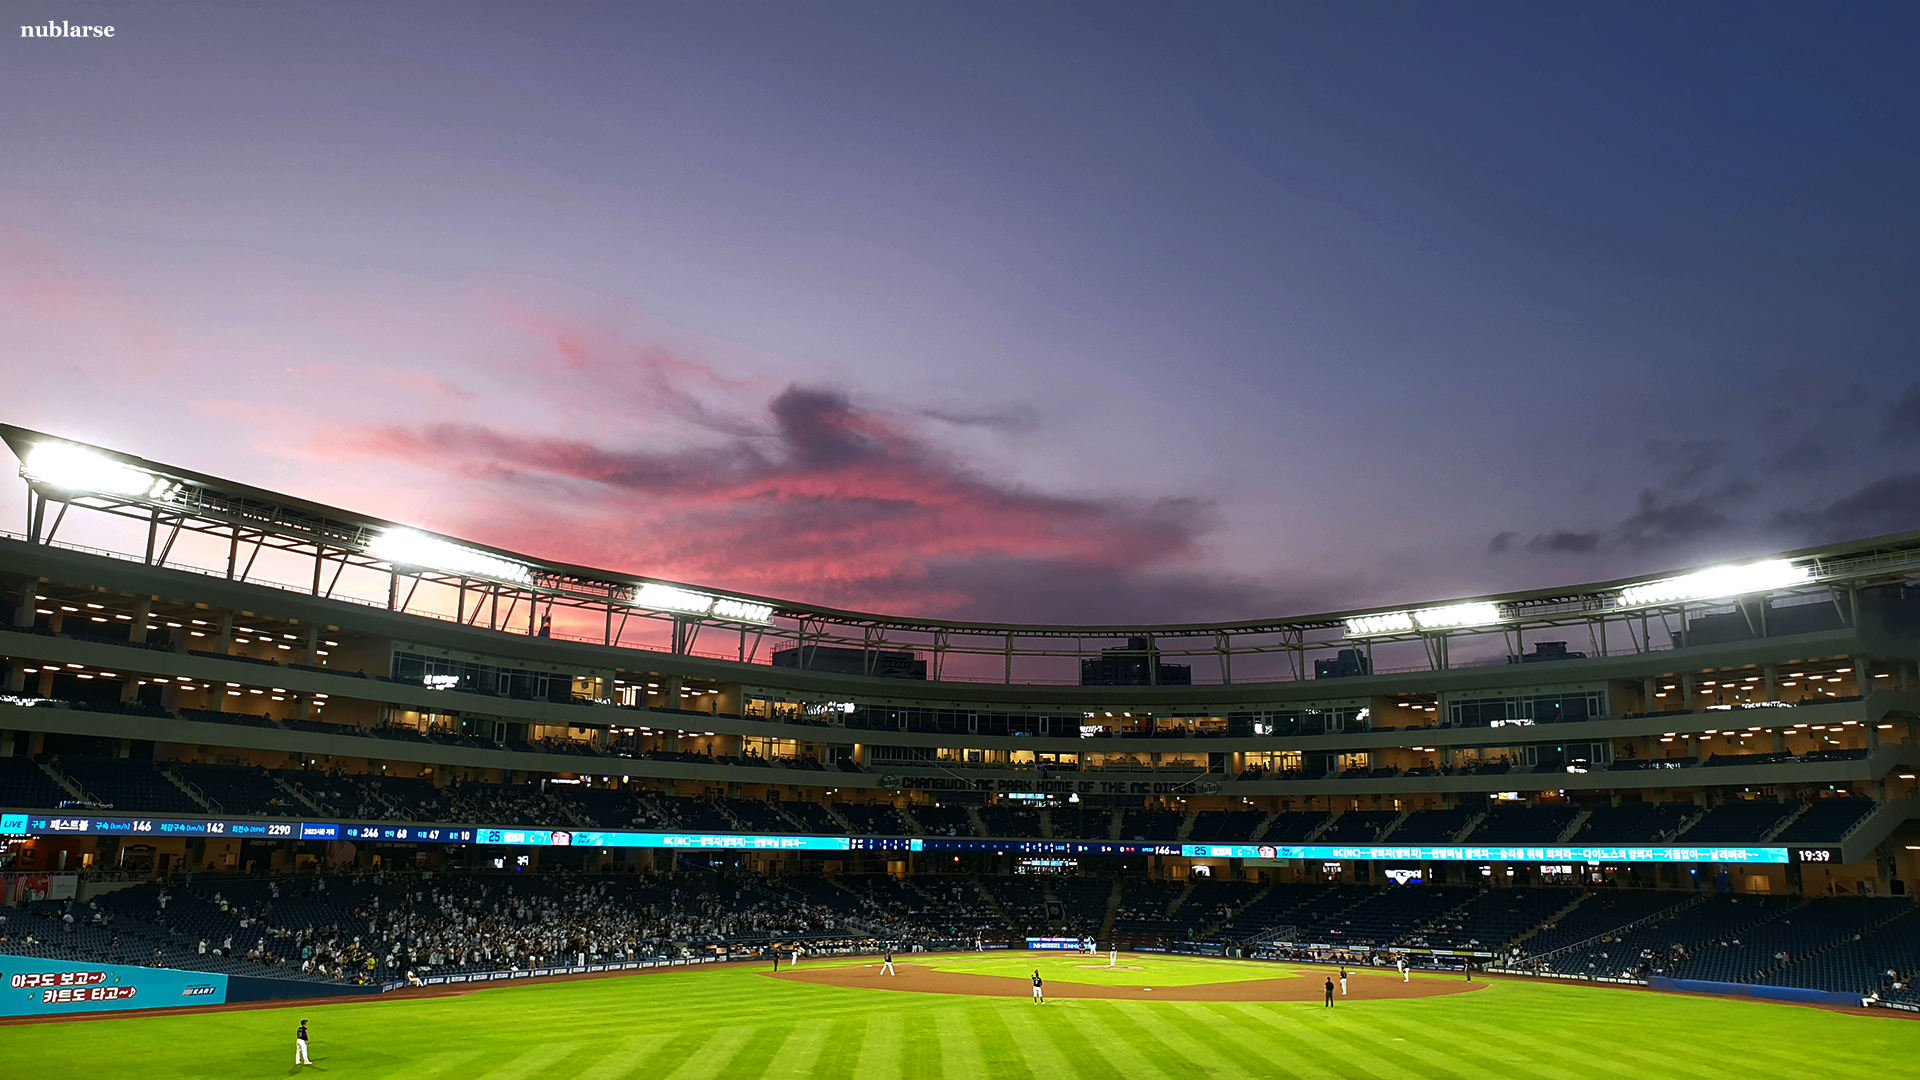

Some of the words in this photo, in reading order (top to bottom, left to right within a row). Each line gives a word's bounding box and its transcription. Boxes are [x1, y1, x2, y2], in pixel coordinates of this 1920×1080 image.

[902, 777, 972, 790] CHANGWON
[975, 779, 994, 791] NC
[998, 779, 1031, 791] PARK
[1037, 780, 1074, 792] HOME
[1078, 781, 1095, 792] OF
[1100, 781, 1126, 793] THE
[1130, 782, 1150, 793] NC
[50, 819, 89, 831] 패스트볼
[95, 821, 109, 831] 구속
[133, 821, 152, 831] 146
[160, 823, 185, 832] 체감구속
[207, 823, 224, 833] 142
[232, 825, 249, 833] 회전수
[268, 825, 291, 835] 2290
[397, 829, 408, 838] 68
[429, 830, 440, 839] 47
[461, 831, 470, 840] 10
[489, 831, 500, 842] 25
[530, 834, 535, 842] C
[1155, 846, 1170, 855] 146
[1195, 847, 1206, 855] 25
[1527, 849, 1544, 860] 위해
[1799, 850, 1830, 861] 19:39
[11, 973, 55, 988] 야구도
[60, 972, 99, 986] 보고~
[43, 988, 86, 1003] 카트도
[91, 986, 127, 1001] 타고~
[193, 987, 215, 995] KART
